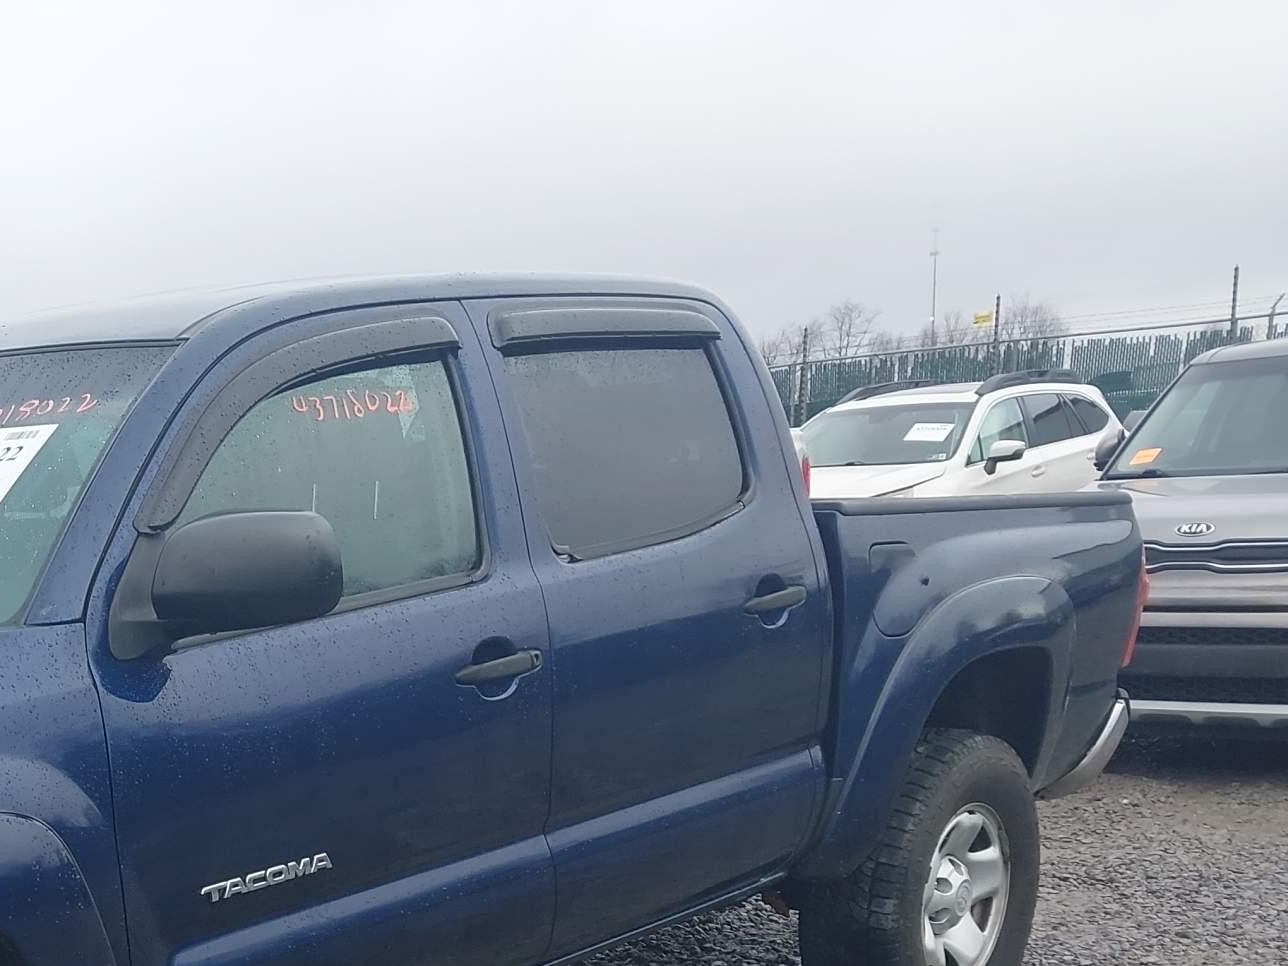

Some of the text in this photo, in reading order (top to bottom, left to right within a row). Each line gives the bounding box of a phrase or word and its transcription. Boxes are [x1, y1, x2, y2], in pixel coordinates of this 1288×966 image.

[291, 389, 413, 421] 43718022
[1180, 523, 1209, 533] KIA
[200, 852, 333, 902] TACOMA
